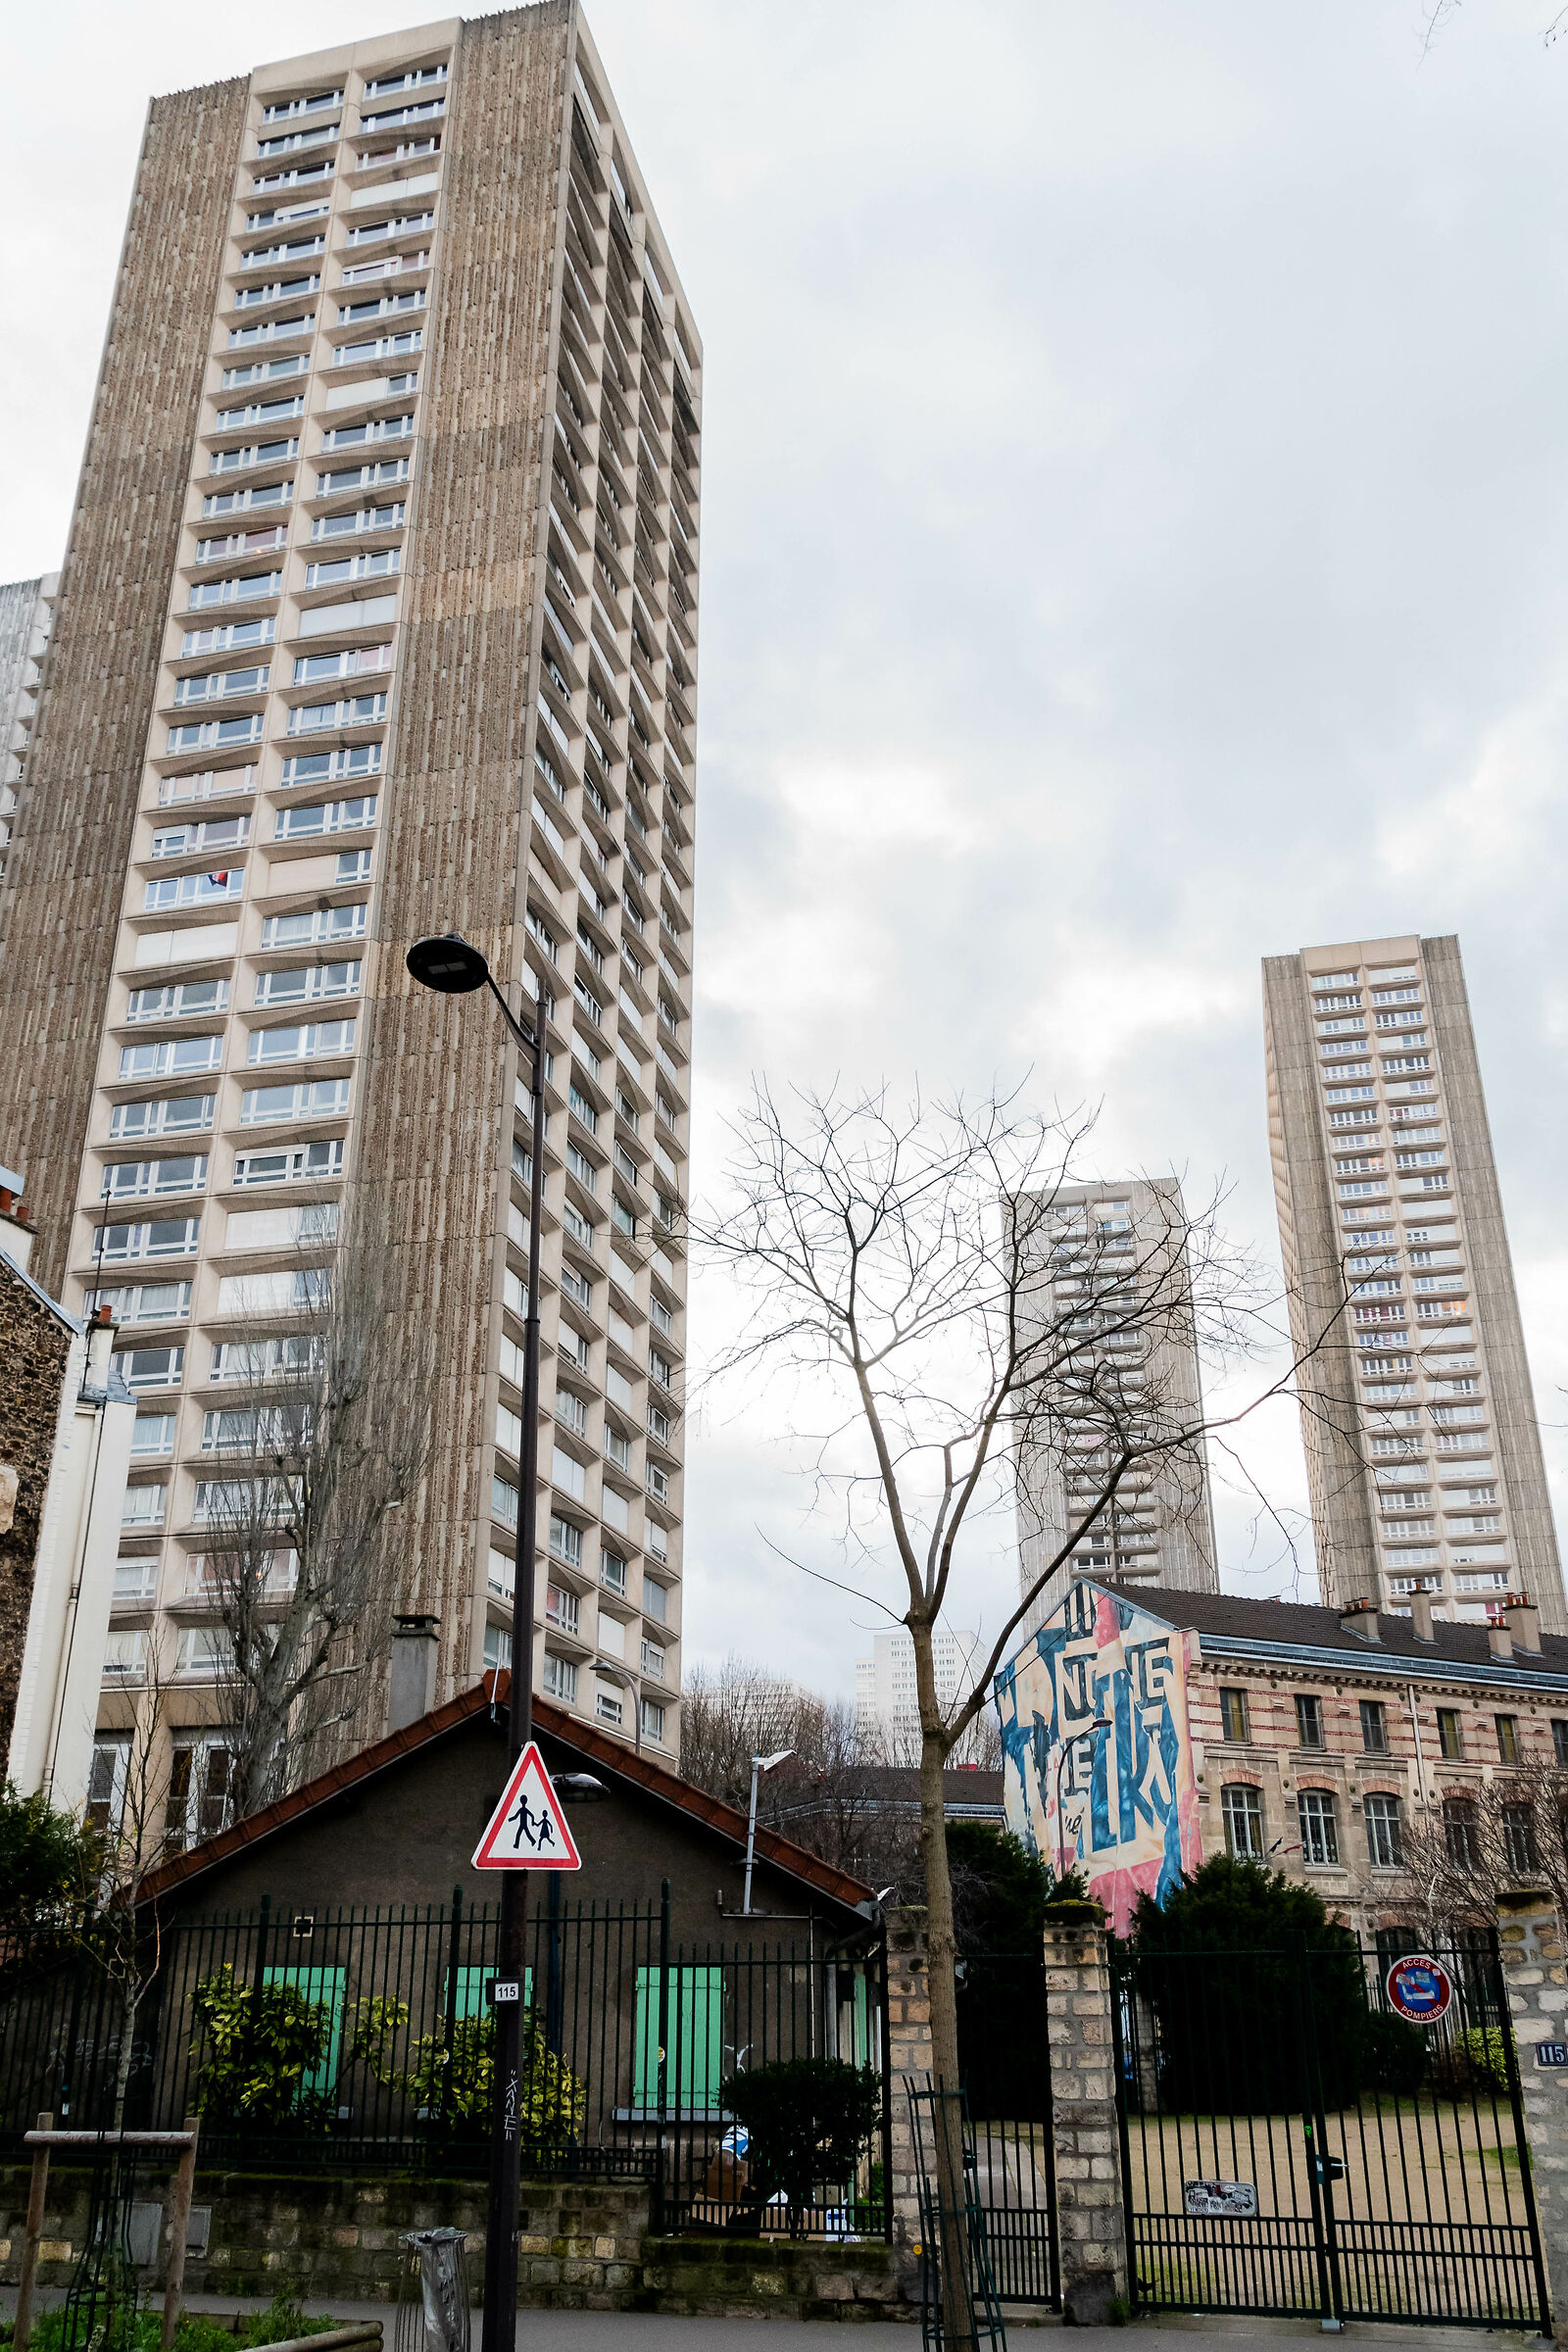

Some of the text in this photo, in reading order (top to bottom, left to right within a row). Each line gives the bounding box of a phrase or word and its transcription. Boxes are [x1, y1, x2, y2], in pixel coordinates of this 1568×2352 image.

[1402, 1958, 1432, 1970] ACCES
[498, 1985, 516, 1998] 115
[1401, 2004, 1444, 2020] POMPIERS
[1541, 2045, 1565, 2063] 115
